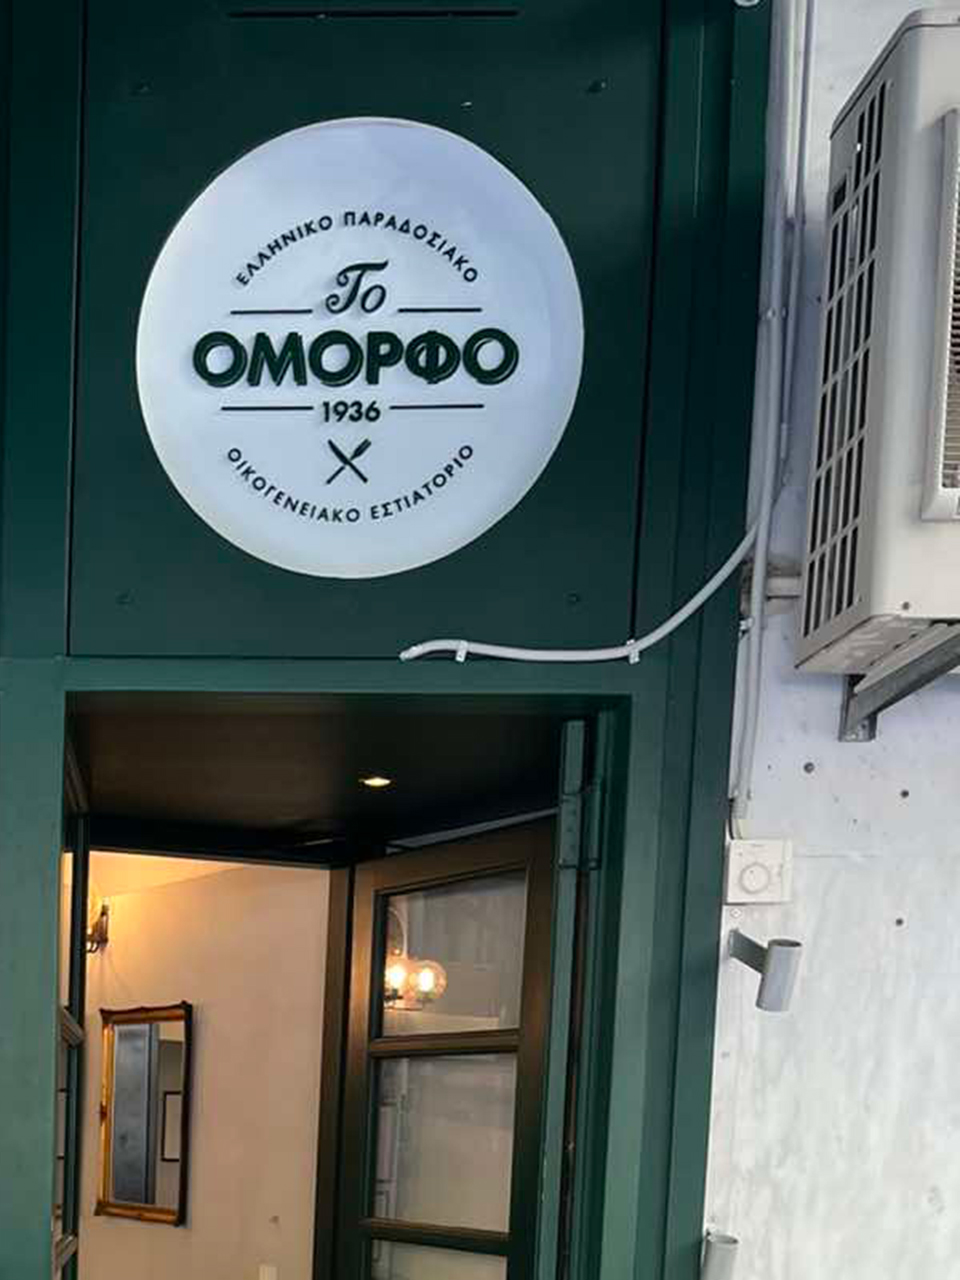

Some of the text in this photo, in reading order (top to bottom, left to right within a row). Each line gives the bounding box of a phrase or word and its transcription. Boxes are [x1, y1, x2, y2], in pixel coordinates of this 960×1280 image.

[236, 211, 479, 286] ΕΛΛΗΝΙΚΟ ΠΑΡΑΔΟΣΙΑΚΟ
[192, 327, 520, 387] ΟΜΟΡΦΟ
[322, 401, 381, 422] 1936
[227, 445, 474, 523] ΟΙΚΟΓΕΝΕΙΑΚΟ ΕΣΤΙΑΤΟΡΙΟ
